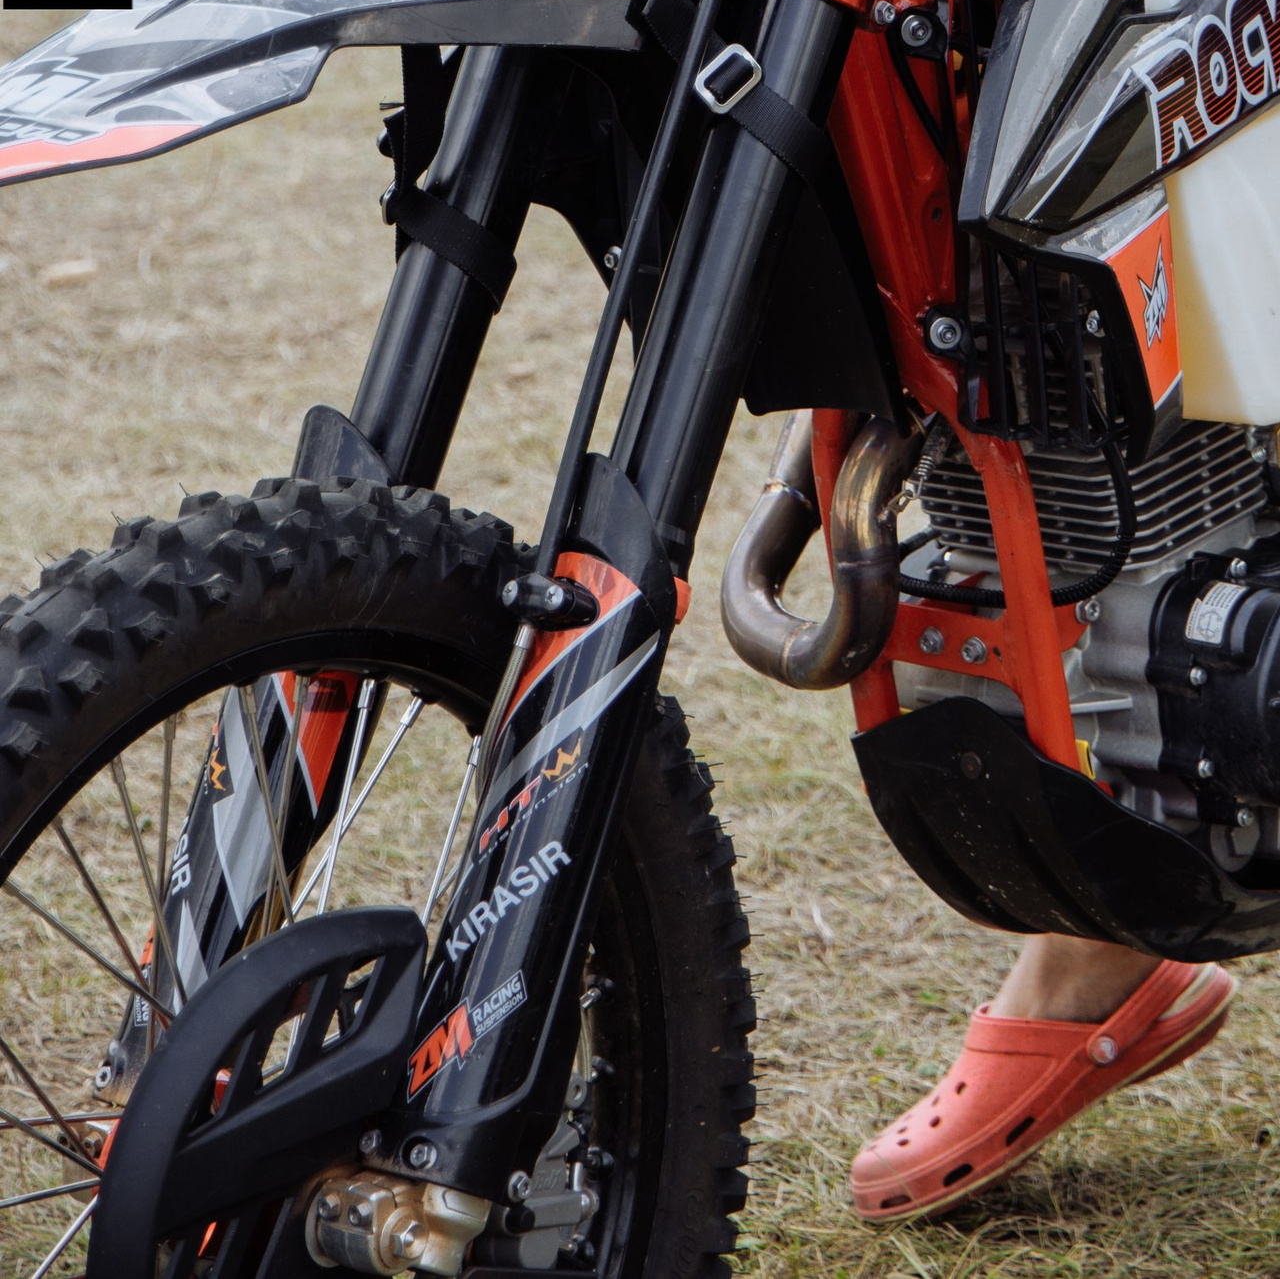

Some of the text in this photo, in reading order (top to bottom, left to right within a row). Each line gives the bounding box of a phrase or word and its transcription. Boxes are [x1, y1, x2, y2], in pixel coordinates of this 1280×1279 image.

[445, 839, 573, 965] KIRASIR
[409, 976, 522, 1097] ZM RACING
[475, 992, 523, 1037] SUSPENSION
